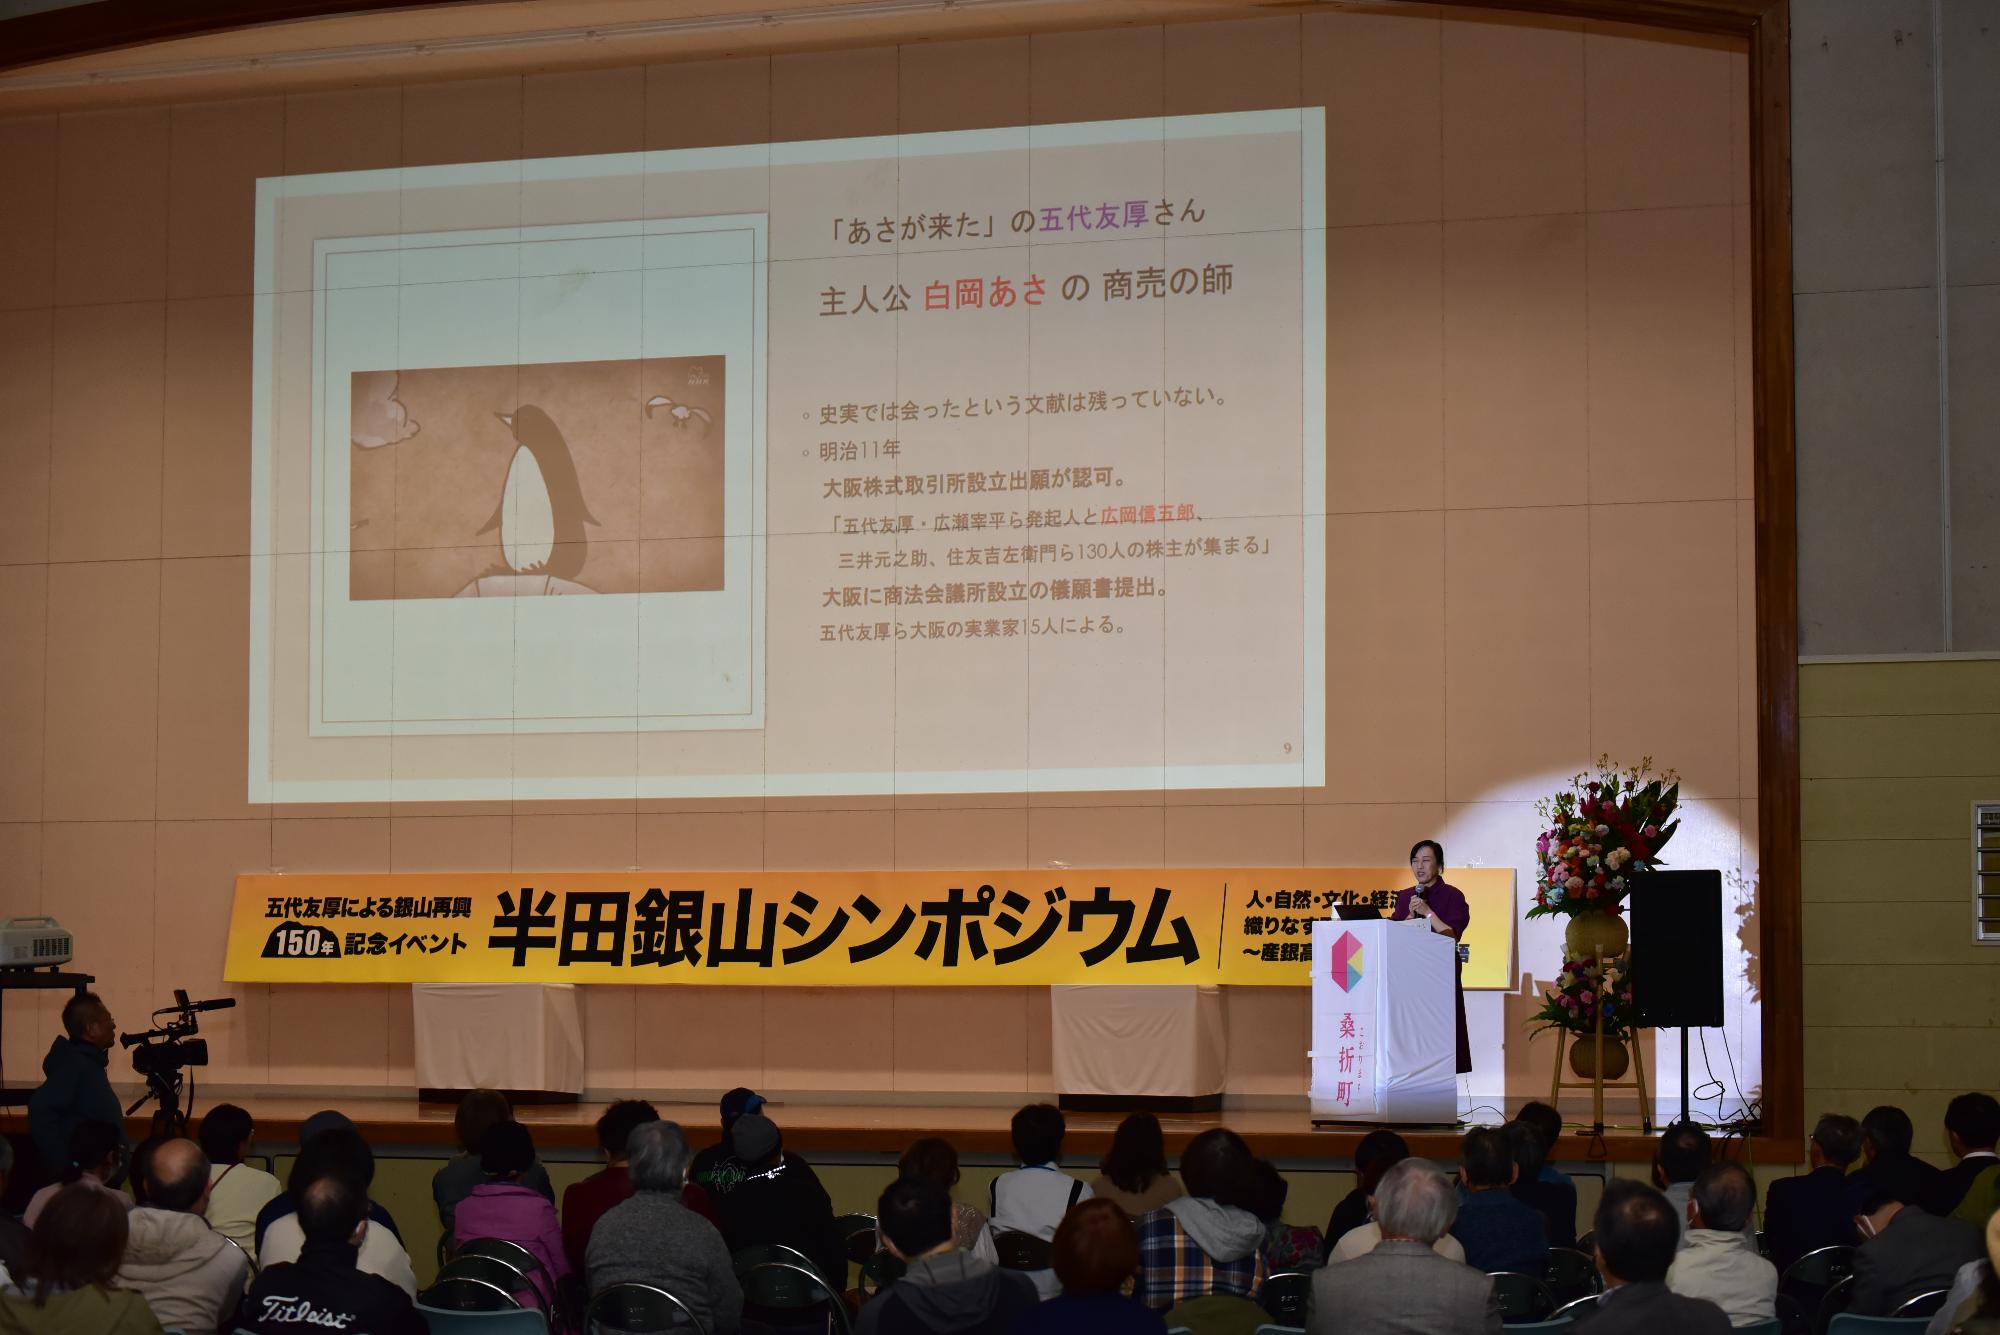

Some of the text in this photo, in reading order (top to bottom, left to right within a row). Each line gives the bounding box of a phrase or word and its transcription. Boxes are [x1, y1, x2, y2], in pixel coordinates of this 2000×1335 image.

[819, 262, 1234, 316] 主人公 白岡あさ の 商売の師
[819, 386, 1225, 426] 史実では会ったという文献は残っていない。
[819, 439, 902, 462] 明治11年
[822, 466, 1125, 499] 大阪株式取引所設立出願が認可。
[819, 615, 1125, 643] 五代友厚ら大阪の実業家15人による。
[1283, 742, 1292, 754] 9
[265, 896, 472, 918] 五代友厚による銀山再興
[276, 929, 467, 956] 150年 記念イベント
[488, 885, 1199, 968] 半田銀山シンポジウム
[1337, 1012, 1355, 1107] 桑折町
[258, 1295, 352, 1329] Titleist
